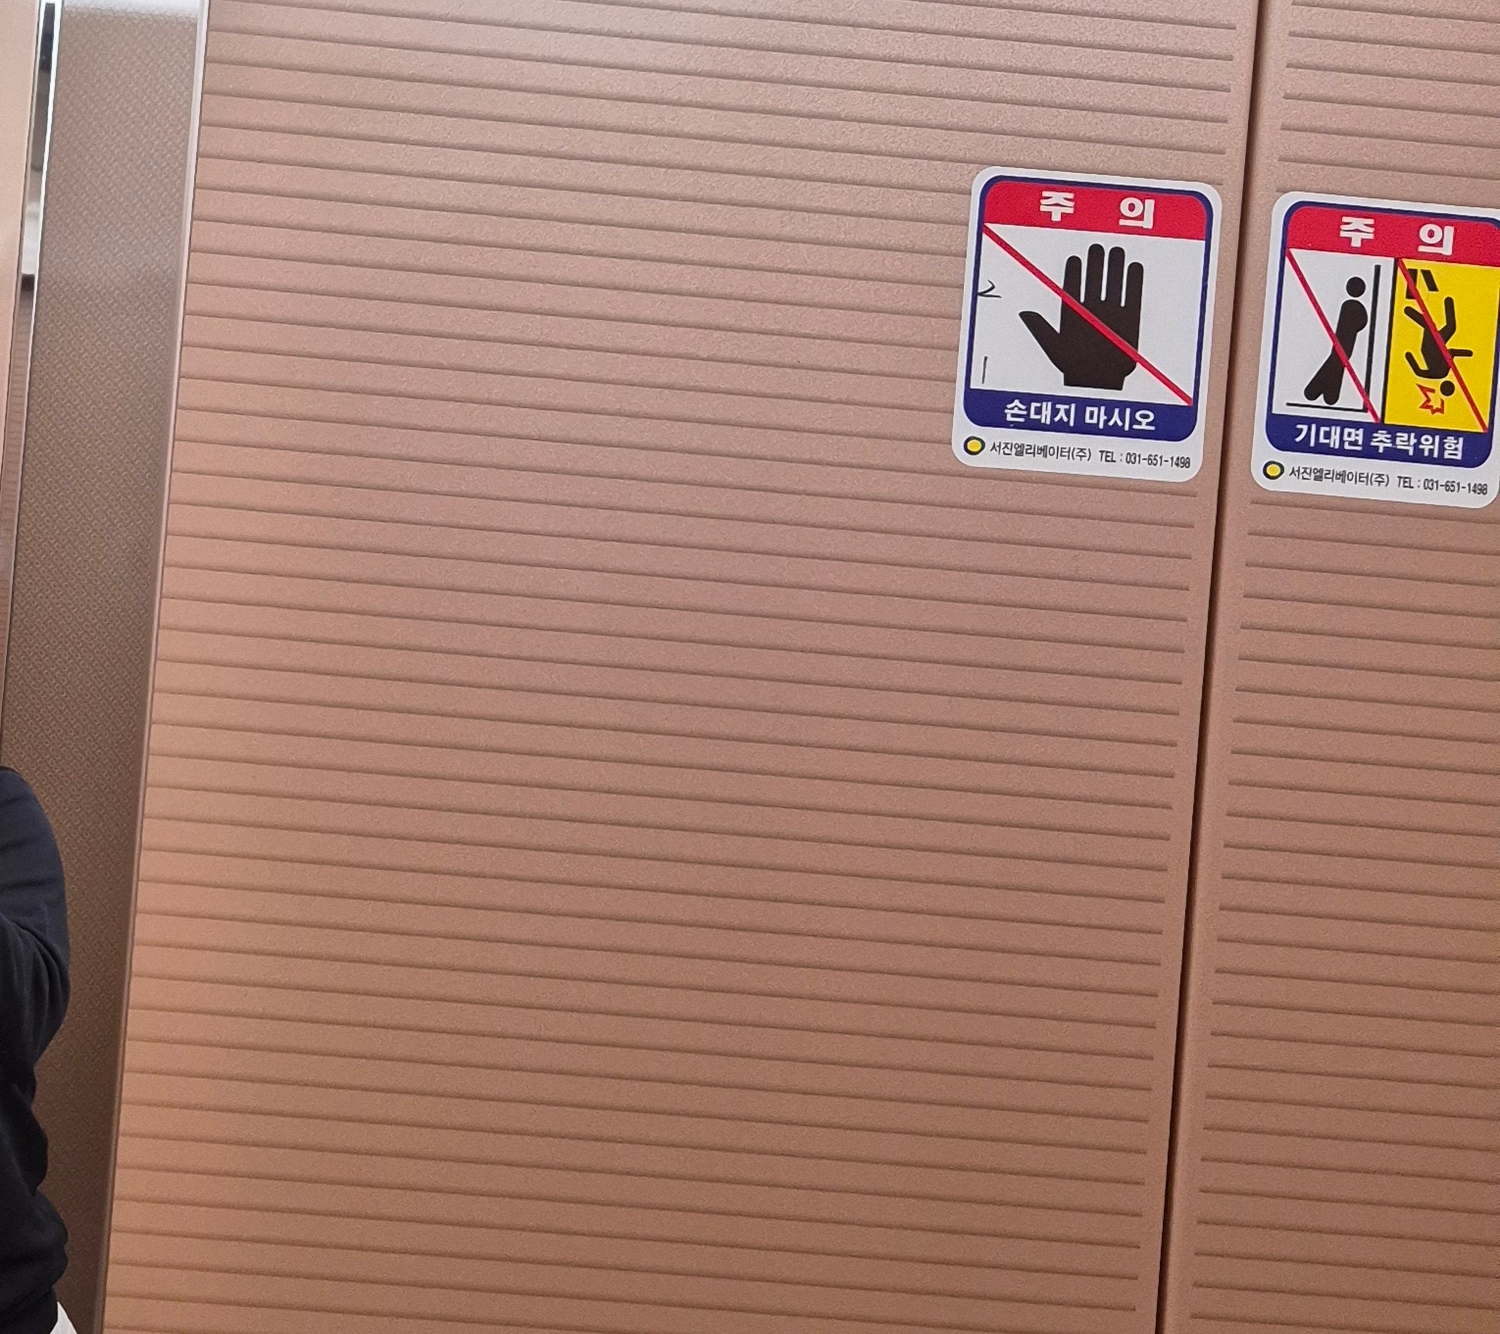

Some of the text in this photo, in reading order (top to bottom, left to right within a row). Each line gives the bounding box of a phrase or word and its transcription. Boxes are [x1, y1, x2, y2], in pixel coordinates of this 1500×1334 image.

[1039, 190, 1156, 229] 주 의
[1339, 216, 1455, 256] 주 의
[1004, 398, 1156, 432] 손대지 마시오
[989, 440, 1092, 463] 서진엘리베이터(주)
[1125, 452, 1191, 469] 031-651-1498
[1294, 423, 1464, 461] 기대면 추락위험
[1289, 466, 1390, 488] 서진엘리베이터(주)
[1423, 479, 1488, 495] 031-651-1498
